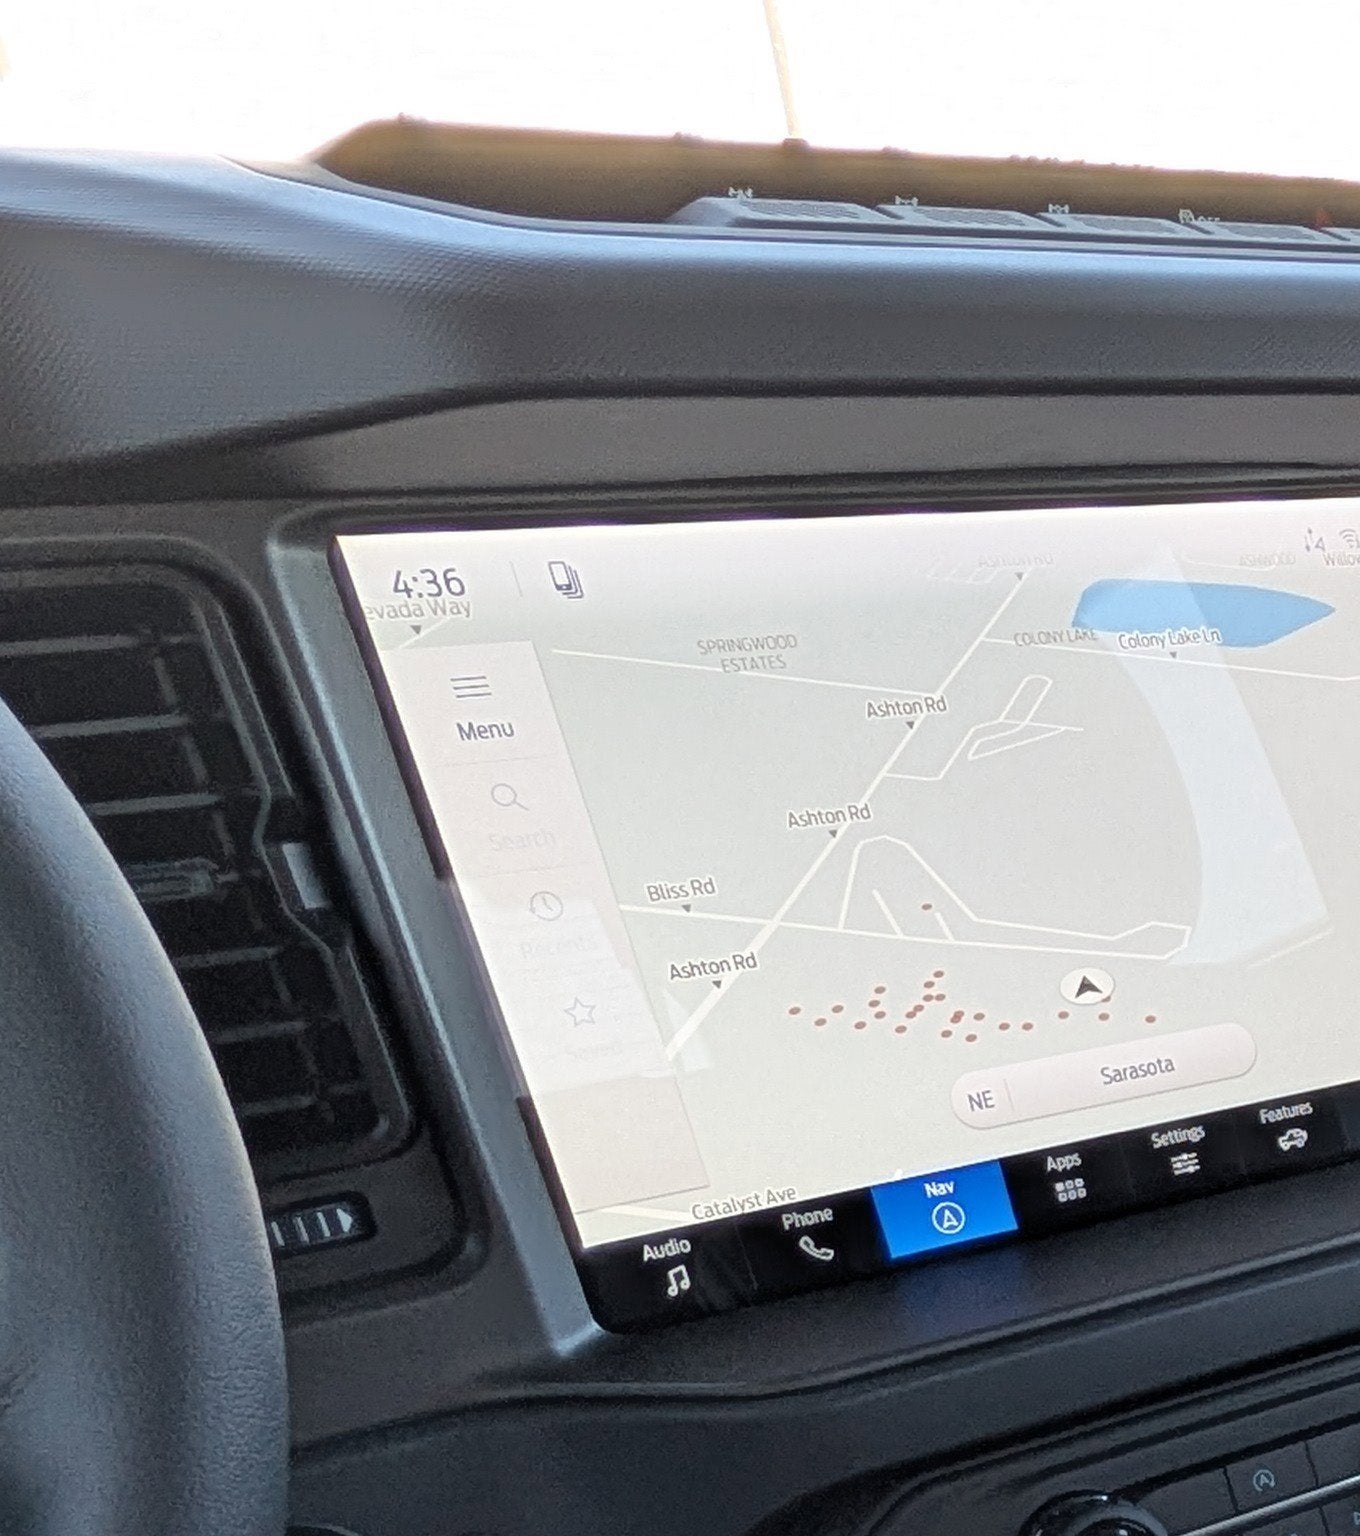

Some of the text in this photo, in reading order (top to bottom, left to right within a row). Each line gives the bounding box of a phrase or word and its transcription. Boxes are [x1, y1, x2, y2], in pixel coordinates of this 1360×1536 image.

[393, 568, 466, 598] 4:36
[425, 597, 471, 618] Way
[697, 634, 798, 655] SPRINGWOOD
[1014, 631, 1064, 648] COLONY
[1118, 632, 1166, 650] Colony
[1168, 630, 1201, 648] Lake
[721, 654, 787, 673] ESTATES
[866, 694, 947, 719] Ashton Rd
[456, 719, 515, 742] Menu
[787, 803, 871, 830] Ashton Rd
[647, 877, 716, 902] Bliss Rd
[669, 952, 757, 981] Ashton Rd
[967, 1057, 1175, 1112] NE Sarasota
[1259, 1100, 1313, 1125] Features
[1151, 1123, 1205, 1149] Settings
[1046, 1151, 1082, 1172] Apps
[925, 1179, 955, 1198] Nav
[691, 1186, 797, 1221] Catalyst Ave
[782, 1206, 833, 1231] Phone
[643, 1237, 691, 1262] Audio
